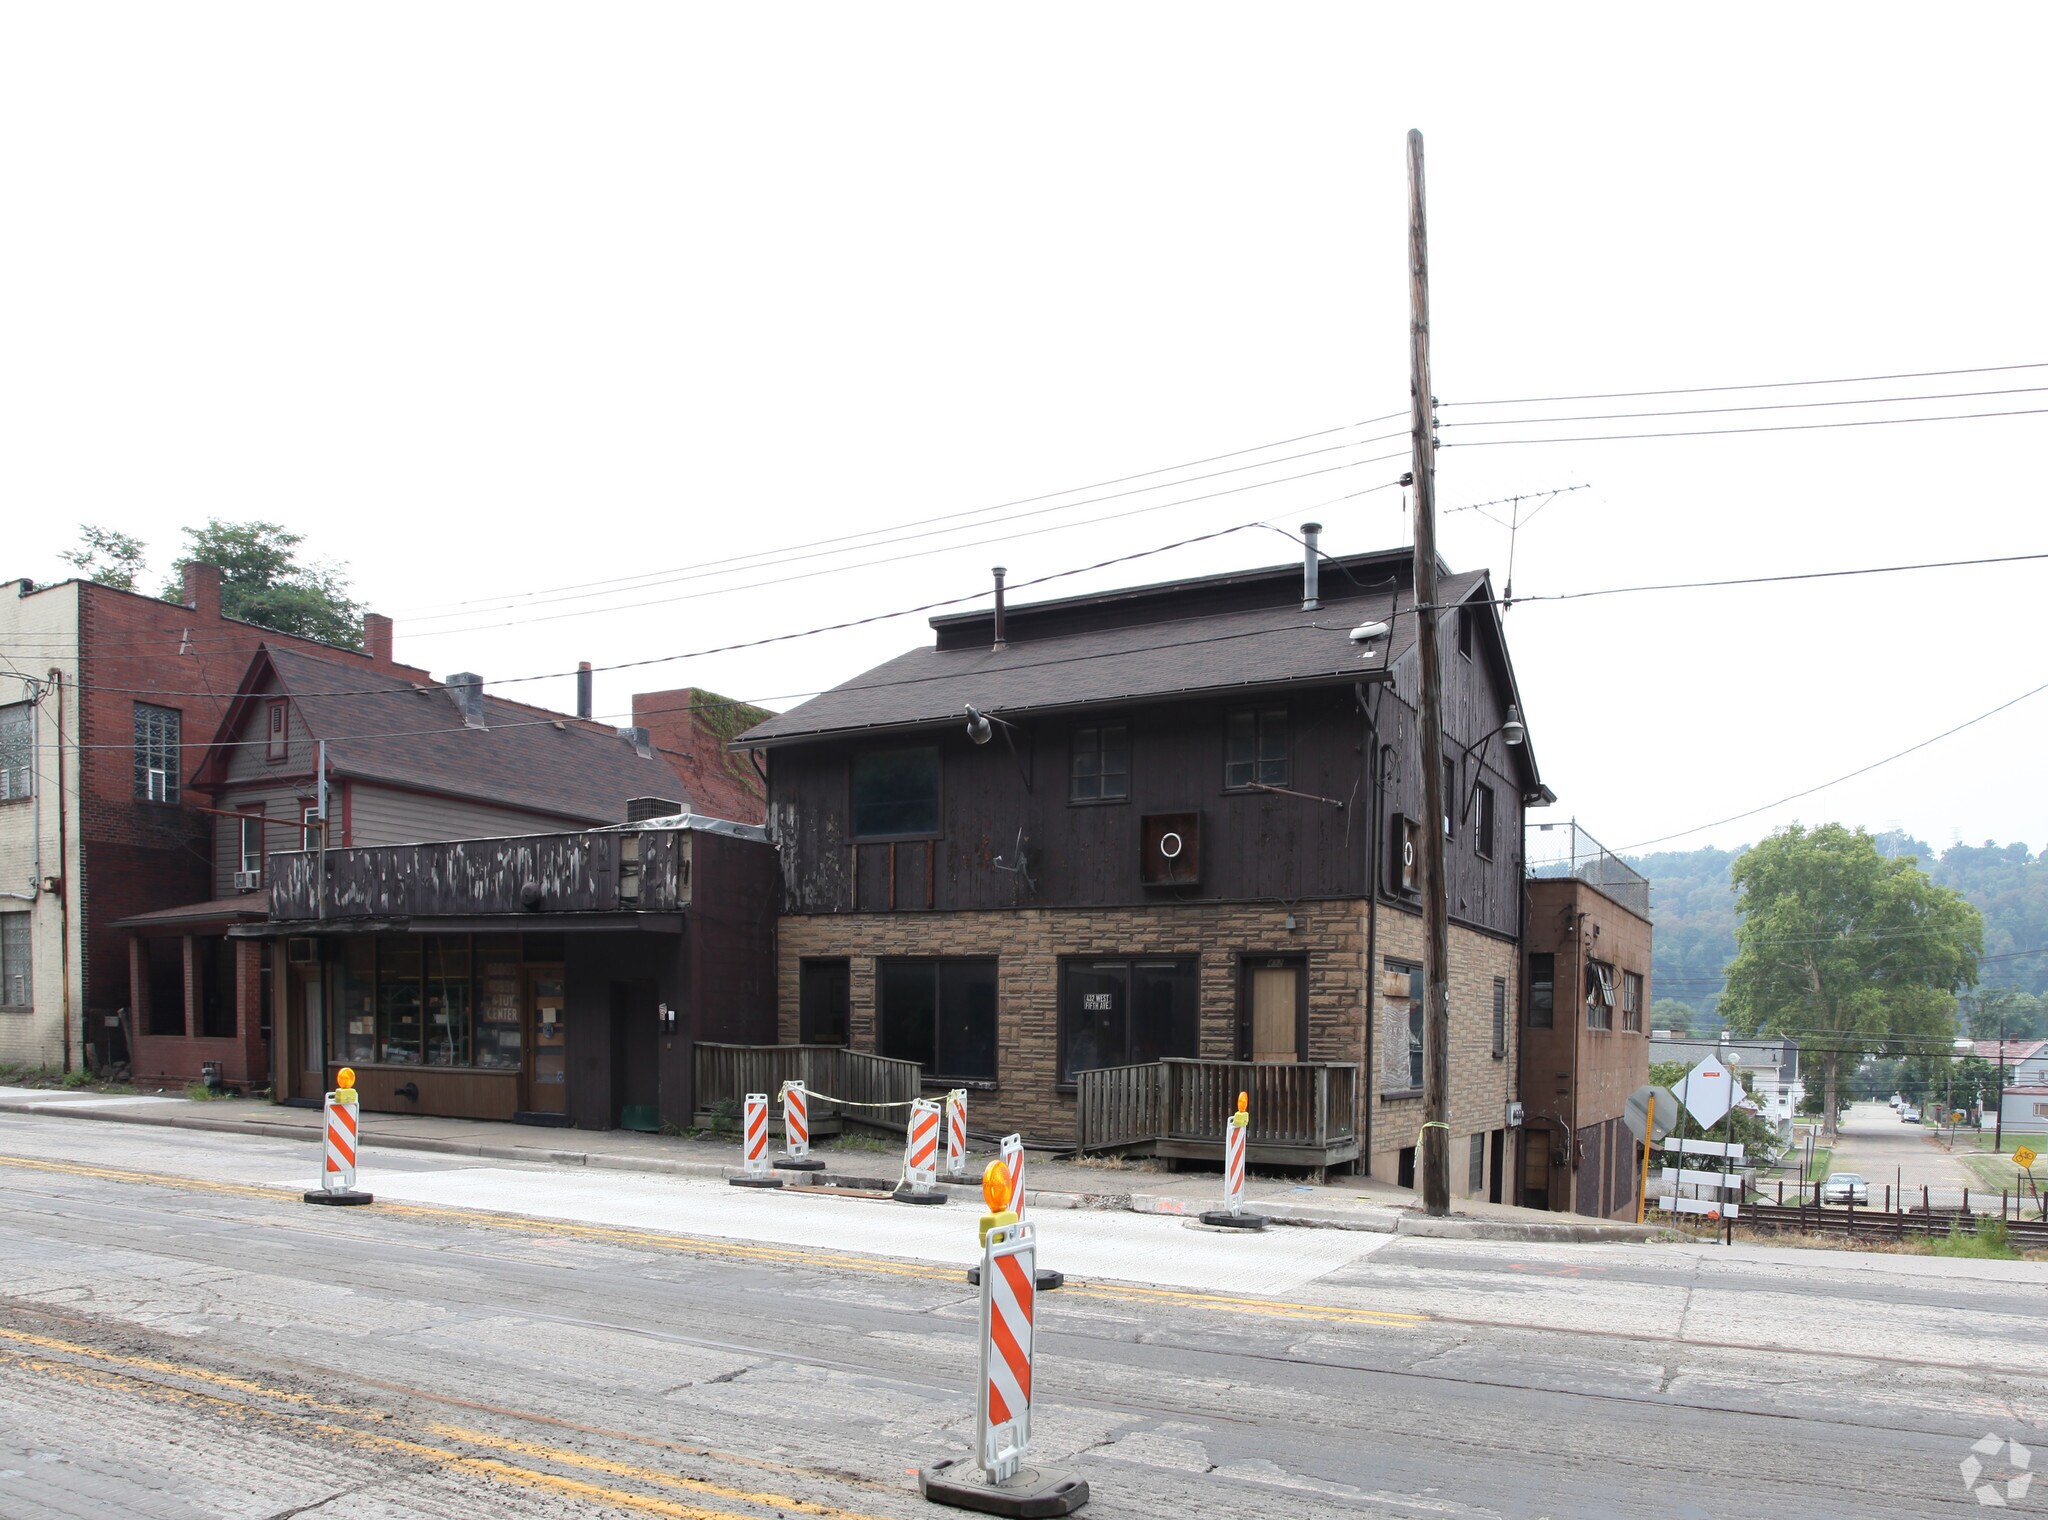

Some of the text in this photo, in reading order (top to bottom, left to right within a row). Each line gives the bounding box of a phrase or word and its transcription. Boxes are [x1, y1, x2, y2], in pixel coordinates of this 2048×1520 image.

[1096, 994, 1109, 1002] WEST
[1085, 1001, 1098, 1010] FIFTH
[486, 1007, 517, 1021] CENTER
